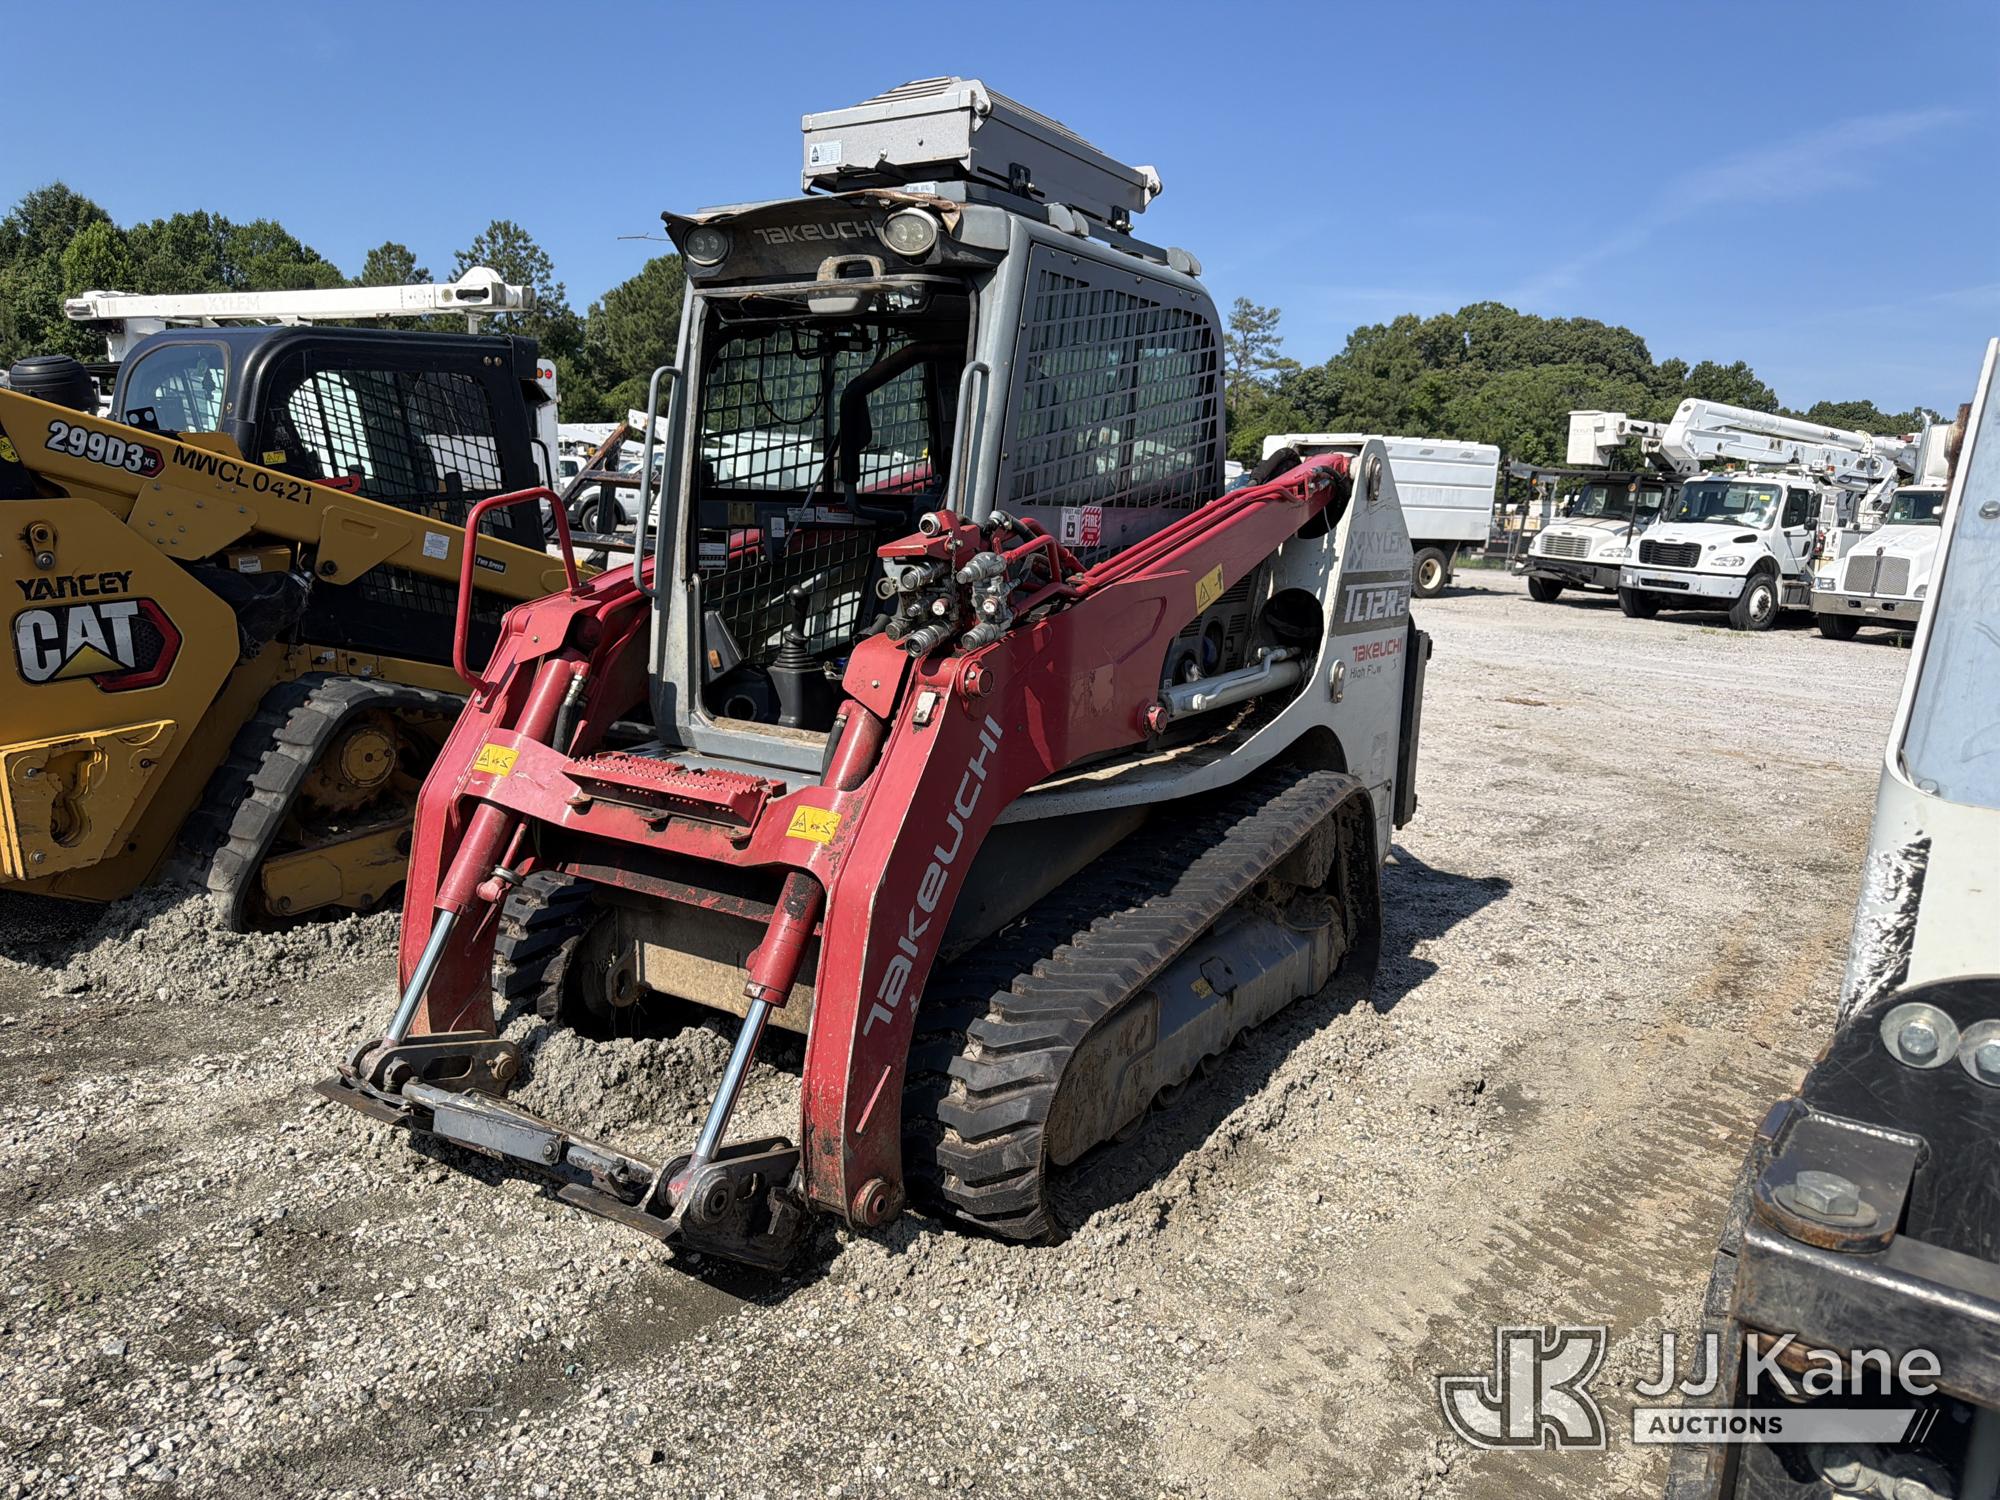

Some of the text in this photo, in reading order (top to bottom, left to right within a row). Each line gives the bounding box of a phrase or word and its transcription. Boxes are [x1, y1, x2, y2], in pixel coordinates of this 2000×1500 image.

[47, 421, 156, 473] 299D3 XE
[1085, 514, 1098, 527] FIRE
[16, 571, 133, 600] YANCEY
[16, 601, 139, 682] CAT
[1352, 637, 1402, 663] TAKEUCHI
[863, 715, 1003, 1036] TAKEUCHI
